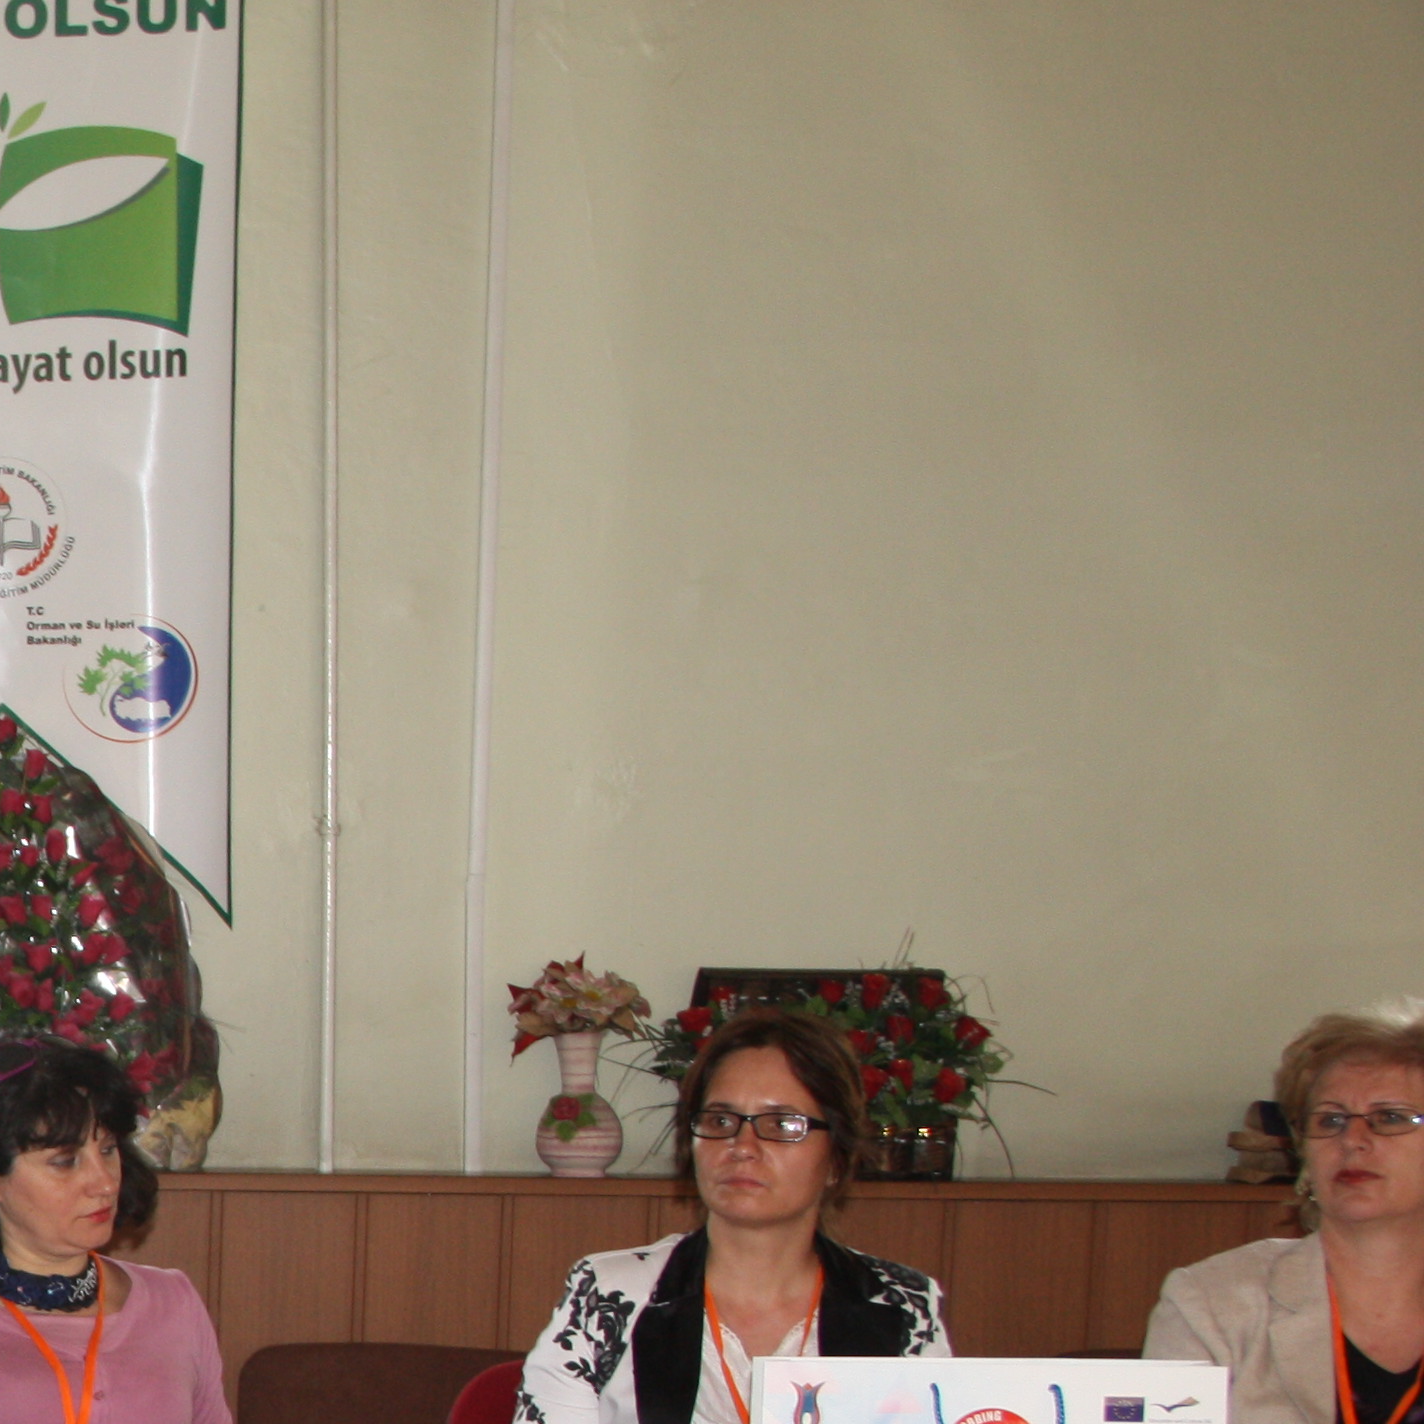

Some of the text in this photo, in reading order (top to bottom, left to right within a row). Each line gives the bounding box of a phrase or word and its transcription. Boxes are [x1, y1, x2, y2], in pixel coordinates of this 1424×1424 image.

[4, 0, 227, 39] OLSUN
[83, 340, 188, 380] olsun
[16, 470, 57, 516] BAKANLIĞI
[29, 536, 76, 590] MÜDÜRLÜĞÜ
[26, 606, 44, 616] T.C
[26, 618, 135, 634] Orman ve Su İşleri
[26, 634, 82, 647] Bakanlığı
